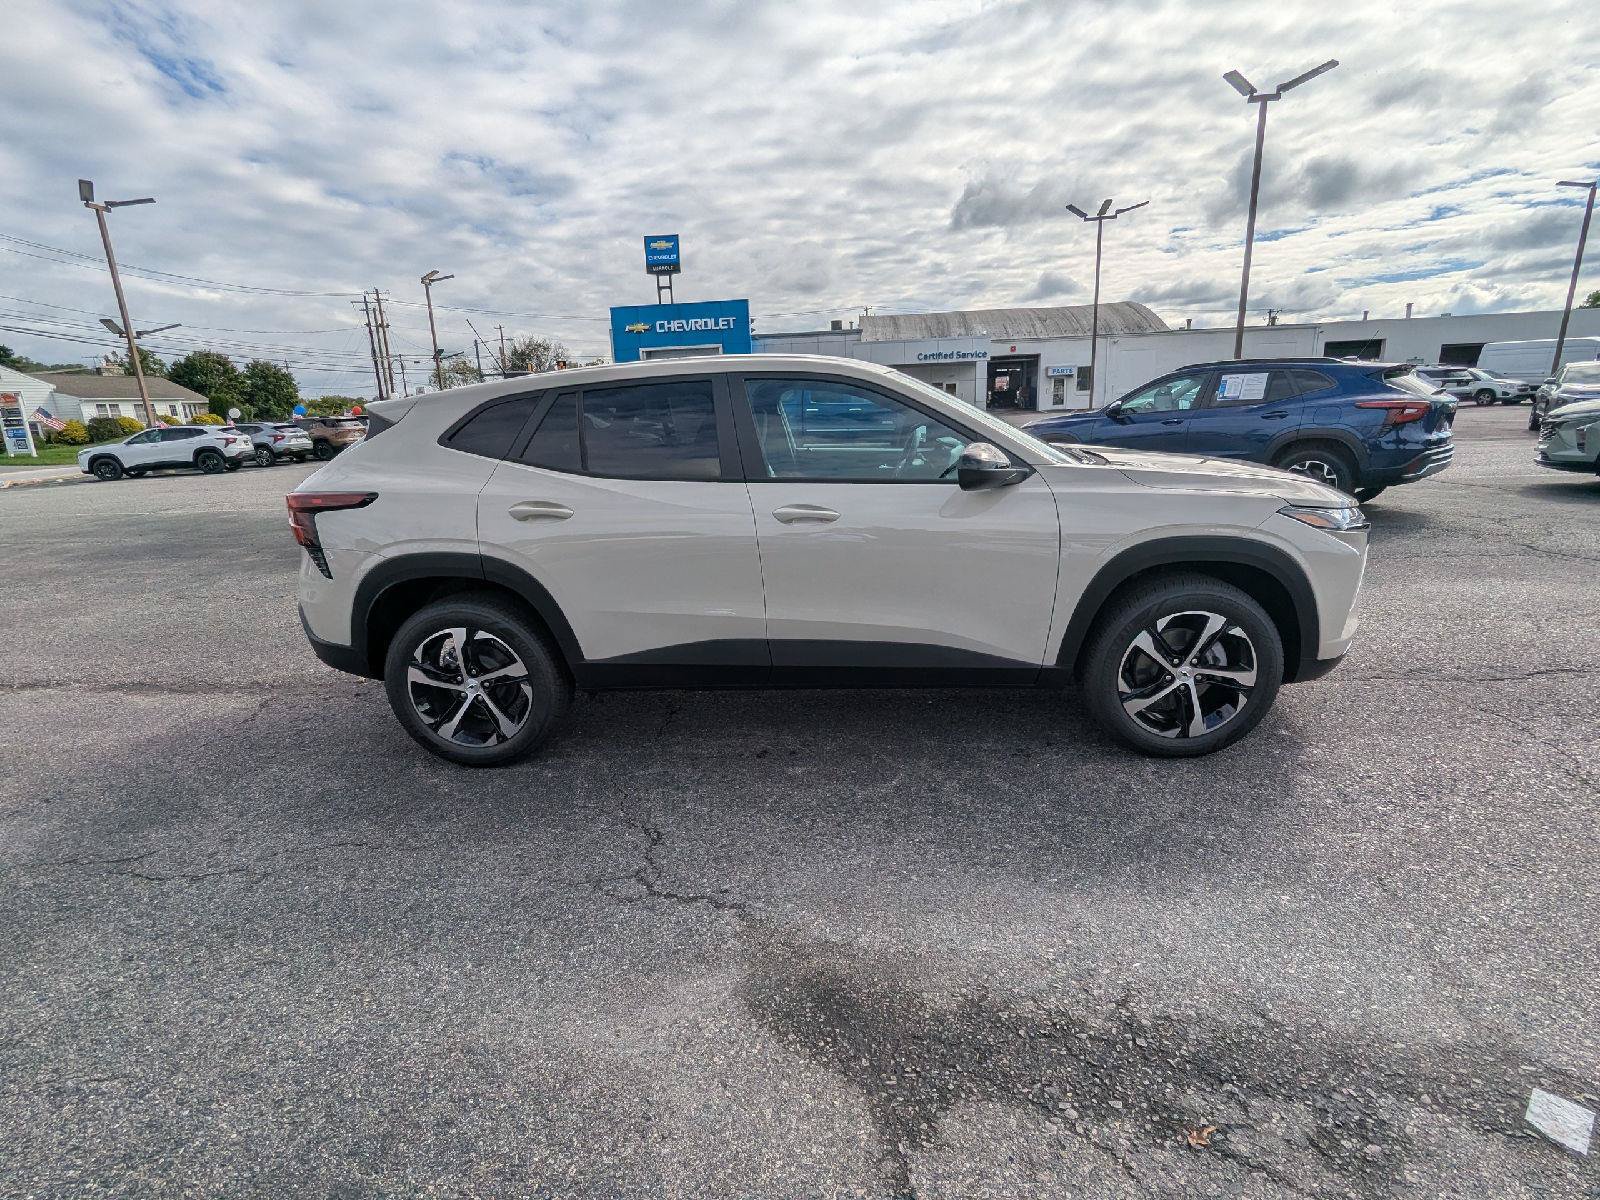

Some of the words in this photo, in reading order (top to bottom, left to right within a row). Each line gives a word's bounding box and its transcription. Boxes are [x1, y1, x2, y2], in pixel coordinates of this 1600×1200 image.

[655, 317, 736, 333] CHEVROLET
[917, 351, 954, 361] Certified
[955, 350, 988, 360] Service
[1052, 367, 1073, 375] PARTS
